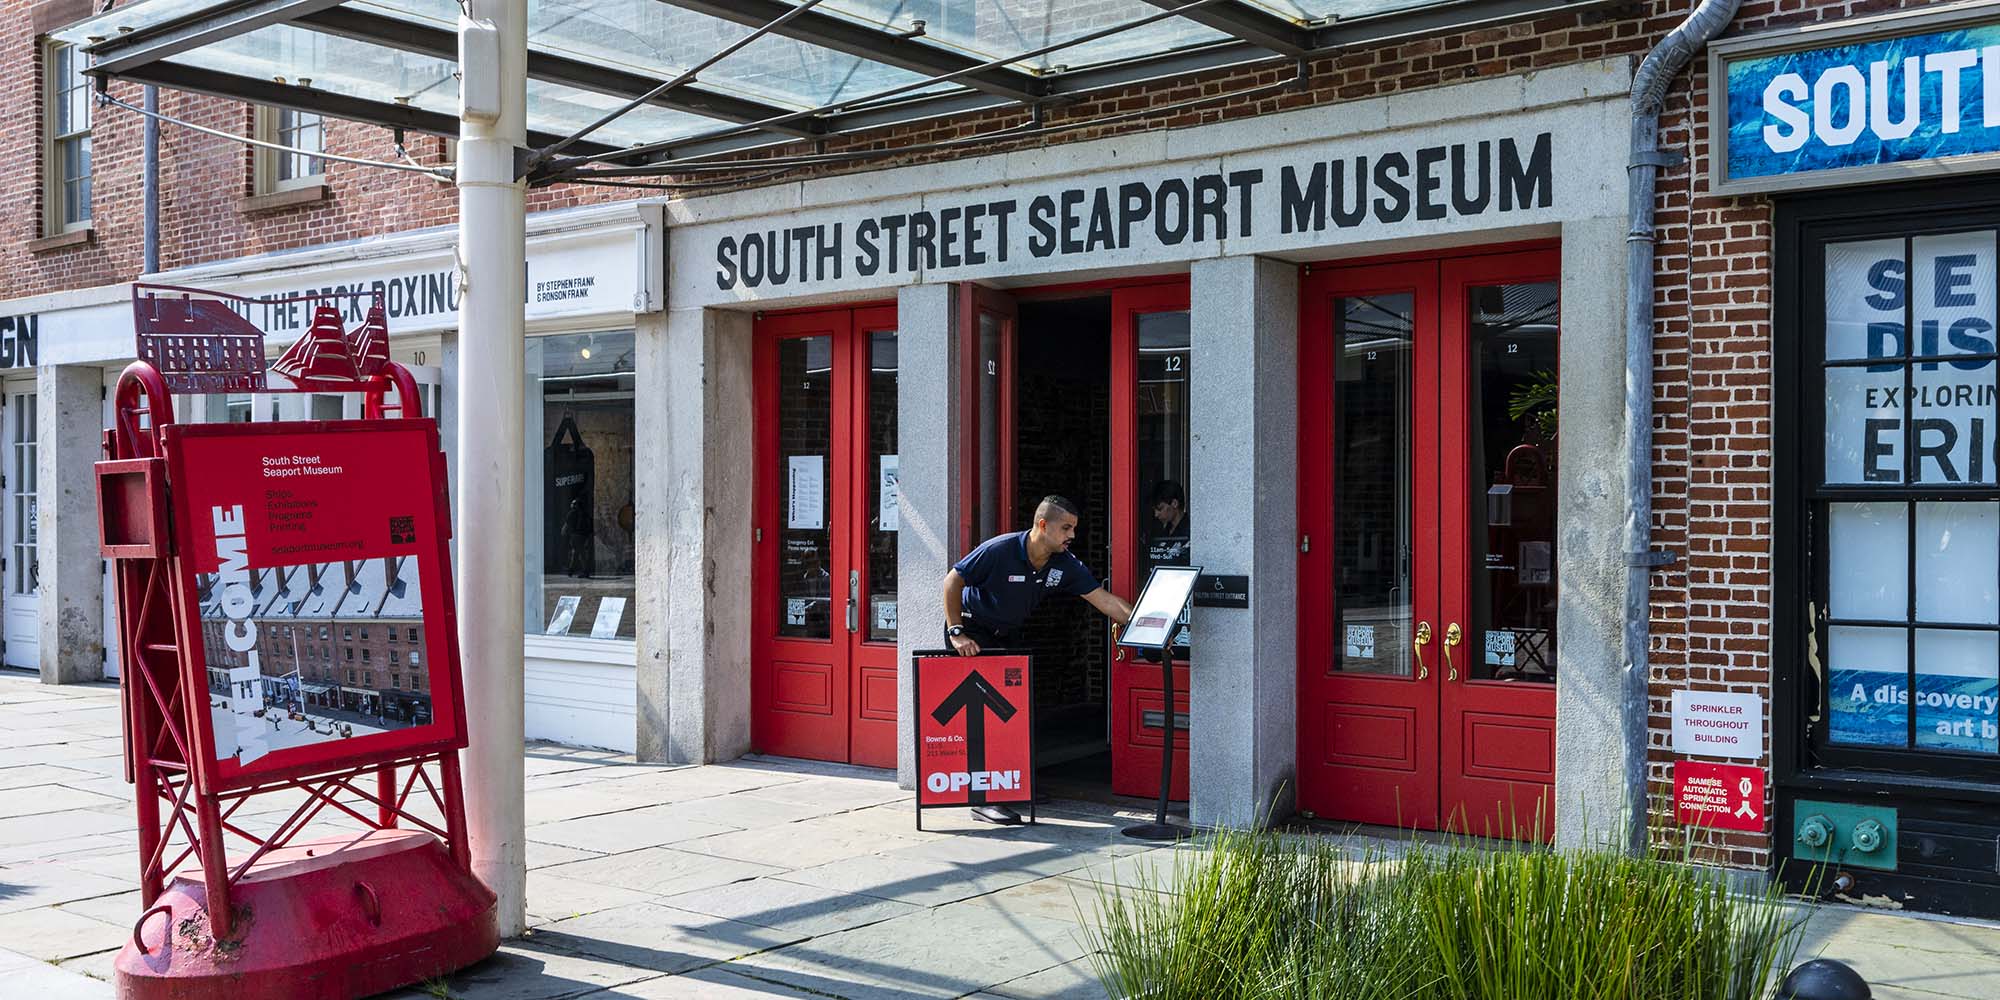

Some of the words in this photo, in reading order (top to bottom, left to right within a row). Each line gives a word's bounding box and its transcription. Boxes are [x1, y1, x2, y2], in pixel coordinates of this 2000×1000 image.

[717, 222, 842, 290] SOUTH
[855, 199, 1017, 277] STREET
[1028, 168, 1263, 258] SEAPORT
[1281, 132, 1552, 235] MUSEUM
[537, 281, 545, 292] BY
[546, 279, 573, 291] STEPHEN
[574, 276, 595, 288] FRANK
[542, 291, 567, 302] RONSON
[568, 288, 589, 298] FRANK
[1508, 343, 1518, 353] 12
[1866, 317, 1994, 373] DIS
[414, 351, 426, 366] 10
[1367, 352, 1377, 360] 12
[1165, 355, 1181, 372] 12
[1864, 418, 1997, 481] ERI
[262, 456, 290, 466] South
[292, 455, 321, 465] Street
[263, 467, 301, 478] Seaport
[303, 465, 343, 476] Museum
[1850, 683, 1868, 703] A
[1874, 684, 1998, 715] discovery
[1690, 704, 1742, 714] SPRINKLER
[1684, 718, 1749, 730] THROUGHOUT
[1936, 718, 1975, 737] art
[1694, 733, 1738, 744] BUILDING
[927, 770, 1021, 793] OPEN!
[1687, 777, 1722, 787] SIAMESE
[1682, 785, 1728, 796] AUTOMATIC
[1683, 794, 1727, 804] SPRINKLER
[1680, 802, 1731, 814] CONNECTION
